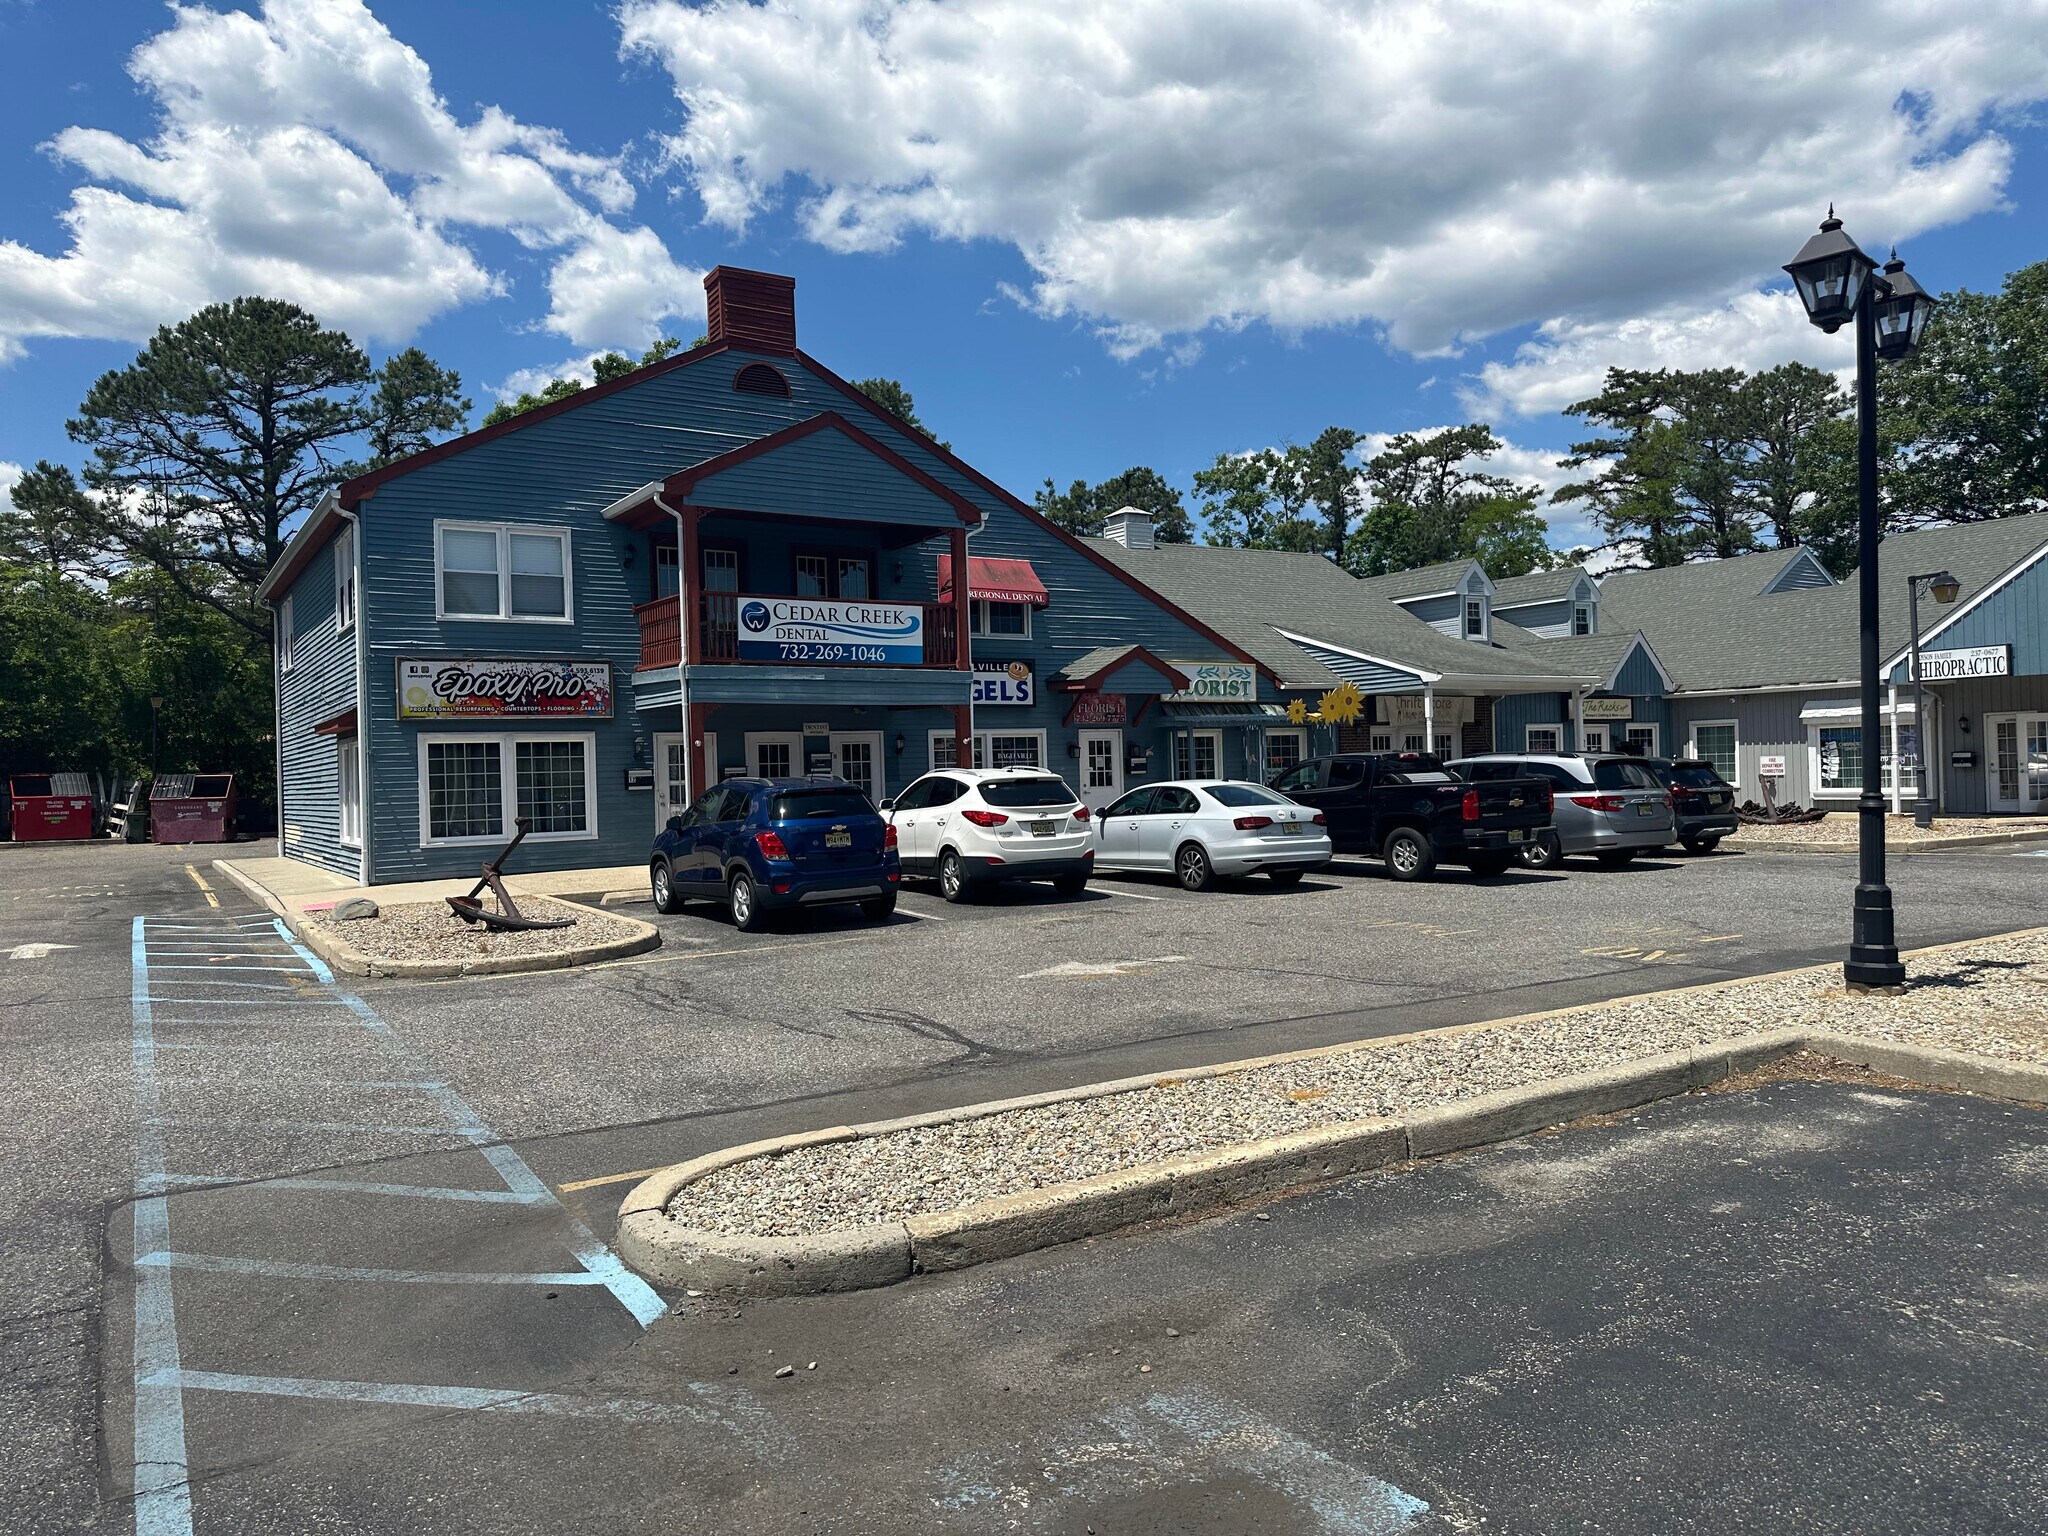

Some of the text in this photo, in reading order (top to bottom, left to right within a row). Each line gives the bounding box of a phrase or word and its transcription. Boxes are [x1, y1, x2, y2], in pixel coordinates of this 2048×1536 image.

[969, 591, 1046, 603] REGIONAL DENTAL
[773, 602, 906, 625] CEDAR CREEK
[775, 628, 829, 641] DENTAL
[780, 644, 886, 662] 732-269-1046
[1911, 656, 2006, 678] HIROPRACTIC
[433, 667, 584, 703] Epoxy Pro
[1078, 703, 1123, 713] FLORIST
[1598, 700, 1619, 712] Racks
